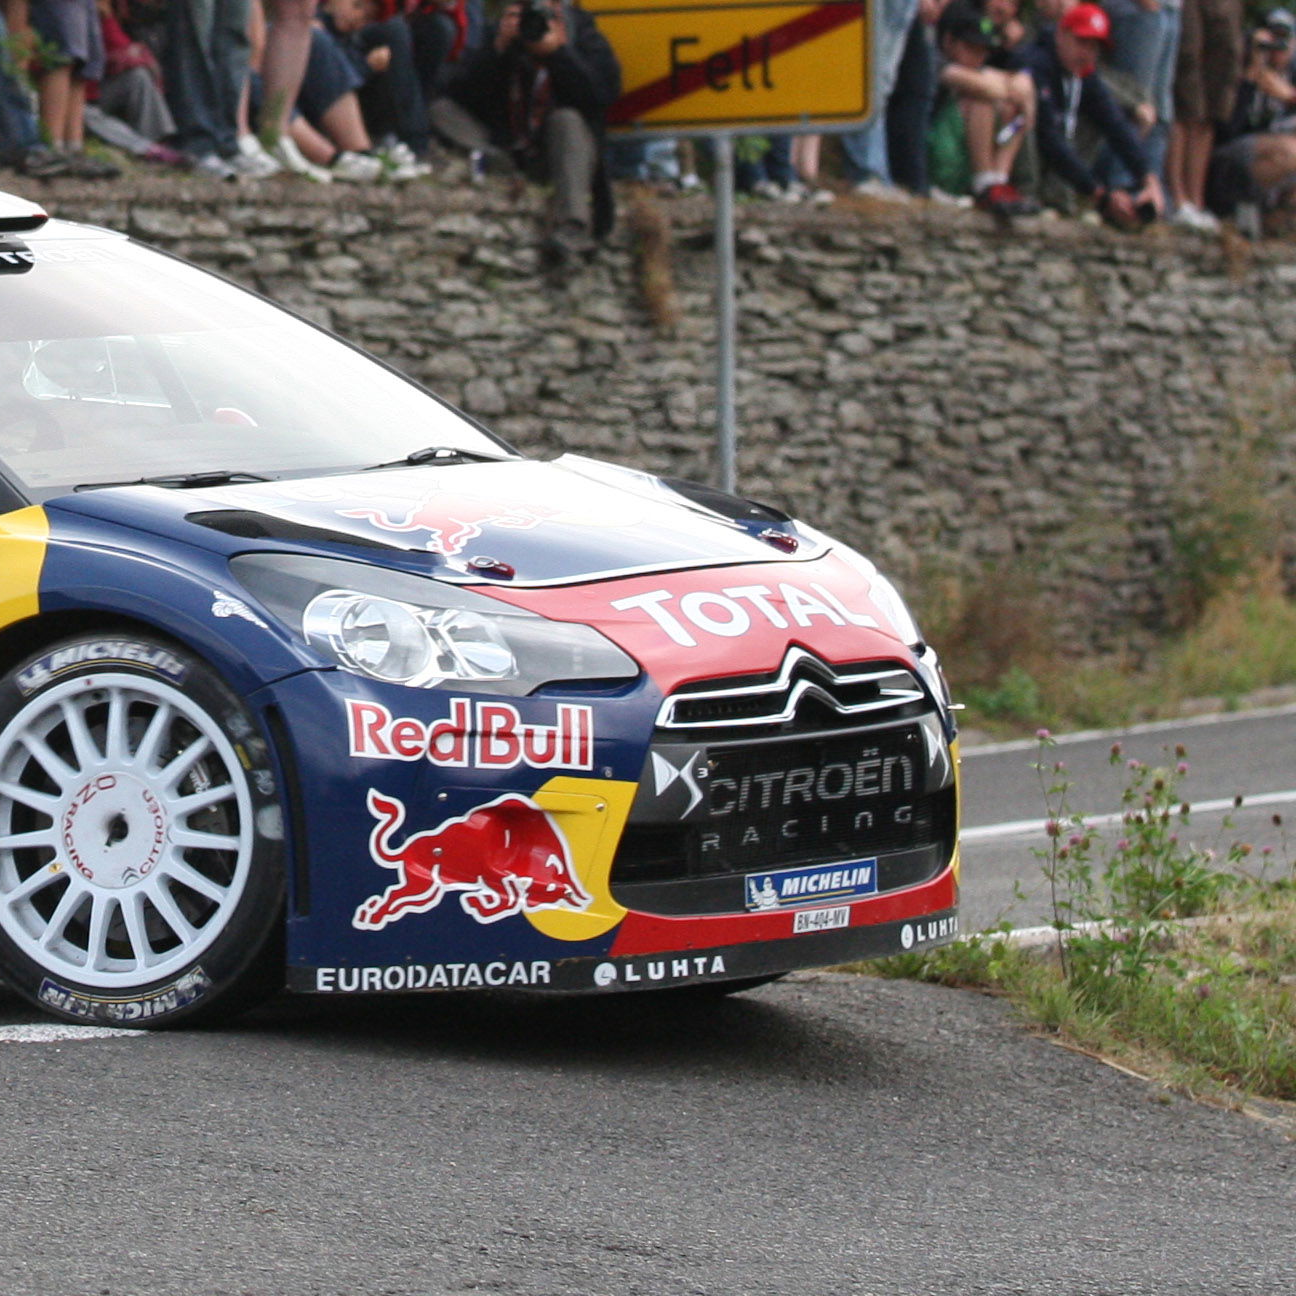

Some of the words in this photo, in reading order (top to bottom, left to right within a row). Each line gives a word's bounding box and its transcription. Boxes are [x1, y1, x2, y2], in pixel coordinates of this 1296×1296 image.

[669, 34, 775, 94] Fell
[611, 582, 879, 647] TOTAL
[709, 747, 913, 815] CITROËN
[781, 867, 872, 897] MICHELIN
[316, 960, 552, 992] EURODATACAR
[625, 955, 726, 983] LUHTA
